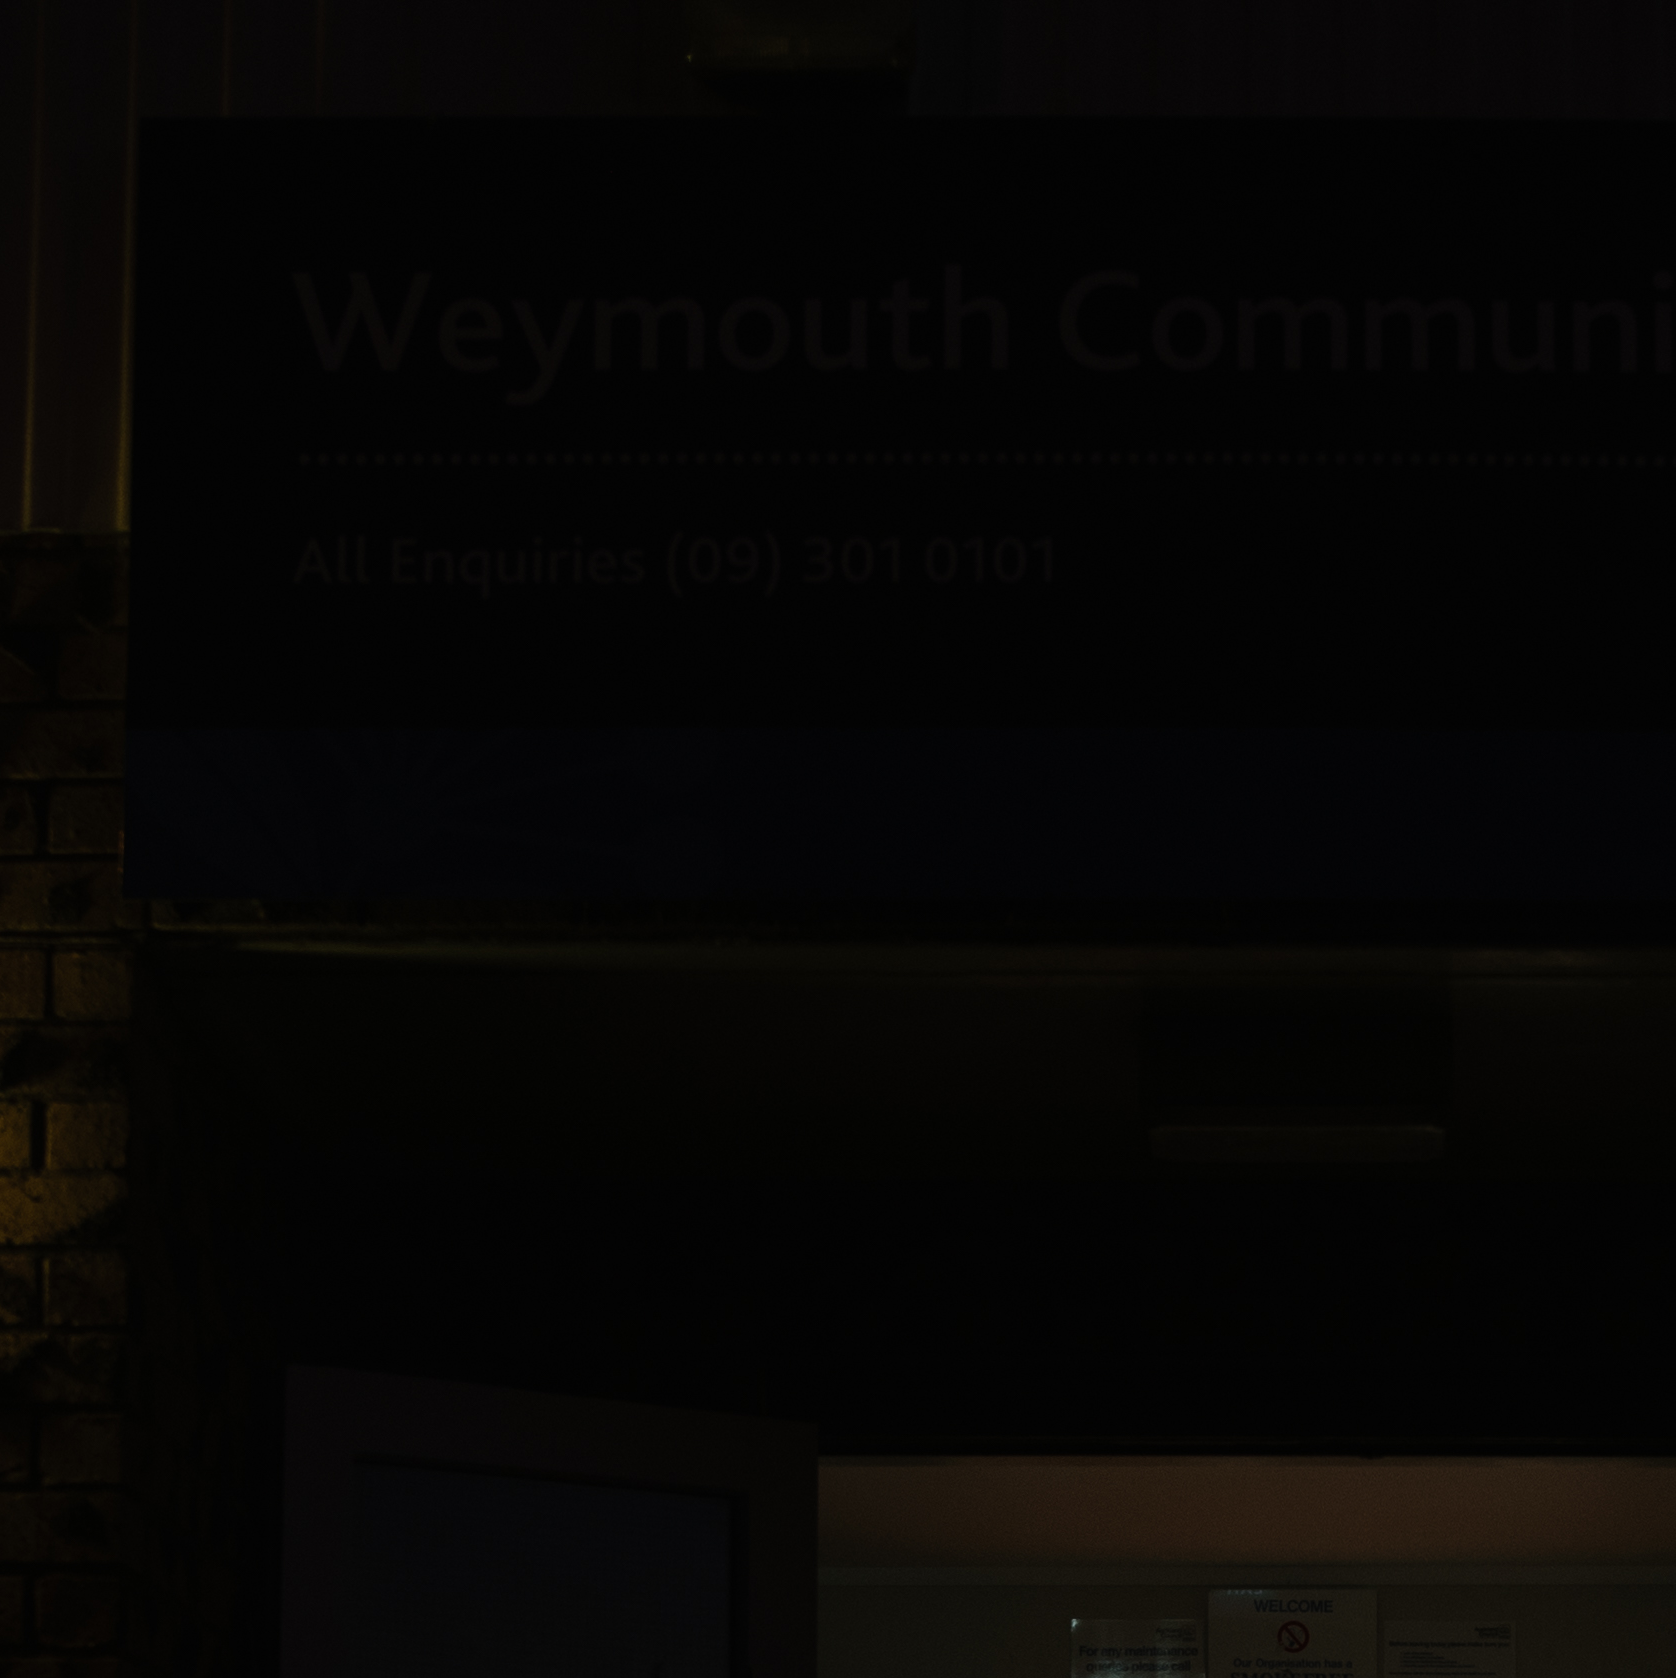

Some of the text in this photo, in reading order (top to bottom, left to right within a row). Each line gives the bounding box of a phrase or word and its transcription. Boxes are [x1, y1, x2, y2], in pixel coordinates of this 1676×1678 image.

[293, 264, 1009, 405] Weymouth
[293, 531, 1054, 599] All Enquiries (09) 301 0101
[1253, 1599, 1333, 1613] WELCOME
[1233, 1658, 1353, 1670] Our Organisation has a
